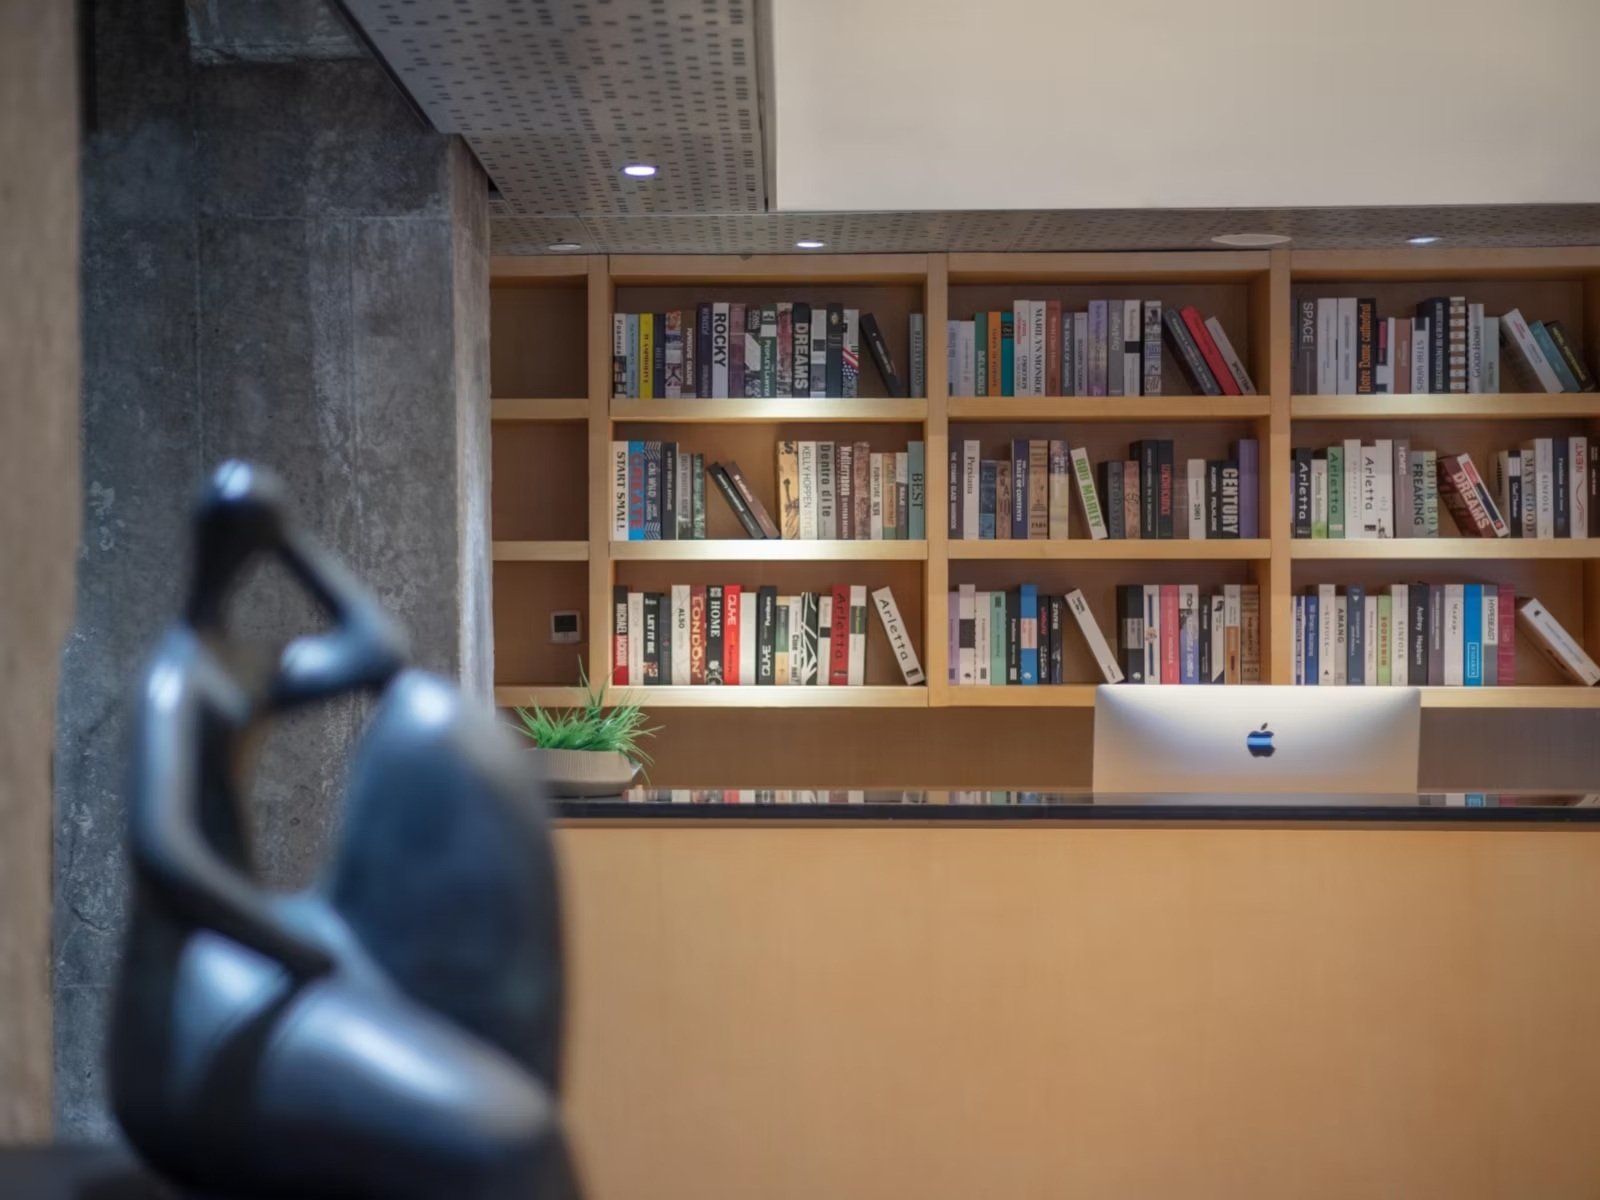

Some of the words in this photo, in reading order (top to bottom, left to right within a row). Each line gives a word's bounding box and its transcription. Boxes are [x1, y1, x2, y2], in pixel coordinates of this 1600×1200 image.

[714, 313, 727, 368] ROCKY
[1034, 308, 1043, 352] MARILYN
[1302, 302, 1314, 344] SPACE
[1473, 325, 1481, 350] HOME
[795, 323, 809, 390] DREAMS
[1358, 344, 1371, 368] Dame
[1416, 340, 1425, 364] STAR
[1472, 352, 1481, 379] GOOD
[1358, 371, 1371, 393] Notre
[1416, 365, 1425, 392] WARS
[616, 451, 626, 489] START
[802, 446, 812, 471] KELLY
[820, 444, 832, 485] Dentro
[966, 456, 976, 495] Persiana
[1524, 457, 1535, 486] MAY
[1575, 442, 1584, 473] NEXT
[630, 453, 644, 529] CREATE
[648, 477, 657, 498] WILD
[803, 473, 813, 508] HOPPEN
[821, 490, 833, 502] di
[911, 472, 924, 510] BEST
[1016, 479, 1023, 488] OF
[1298, 462, 1309, 521] Arletta
[1329, 451, 1340, 515] Arletta
[1364, 456, 1375, 511] Arletta
[1412, 463, 1425, 526] FREAKING
[1426, 459, 1438, 501] BOOK
[616, 491, 626, 532] SMALL
[822, 505, 833, 517] te
[1222, 468, 1239, 534] CENTURY
[1452, 470, 1490, 529] DREAMS
[1525, 493, 1536, 532] GOOD
[616, 603, 628, 634] MICHAEL
[647, 614, 655, 631] LET
[647, 631, 655, 641] IT
[691, 593, 704, 678] LONDON
[710, 601, 721, 638] HOME
[835, 593, 847, 659] Arletta
[879, 599, 909, 662] Arletta
[1337, 608, 1345, 644] AMANG
[1416, 606, 1425, 632] Audrey
[1487, 599, 1497, 641] HYPEBEAST
[647, 641, 655, 654] BE
[1416, 635, 1425, 665] Hepburn
